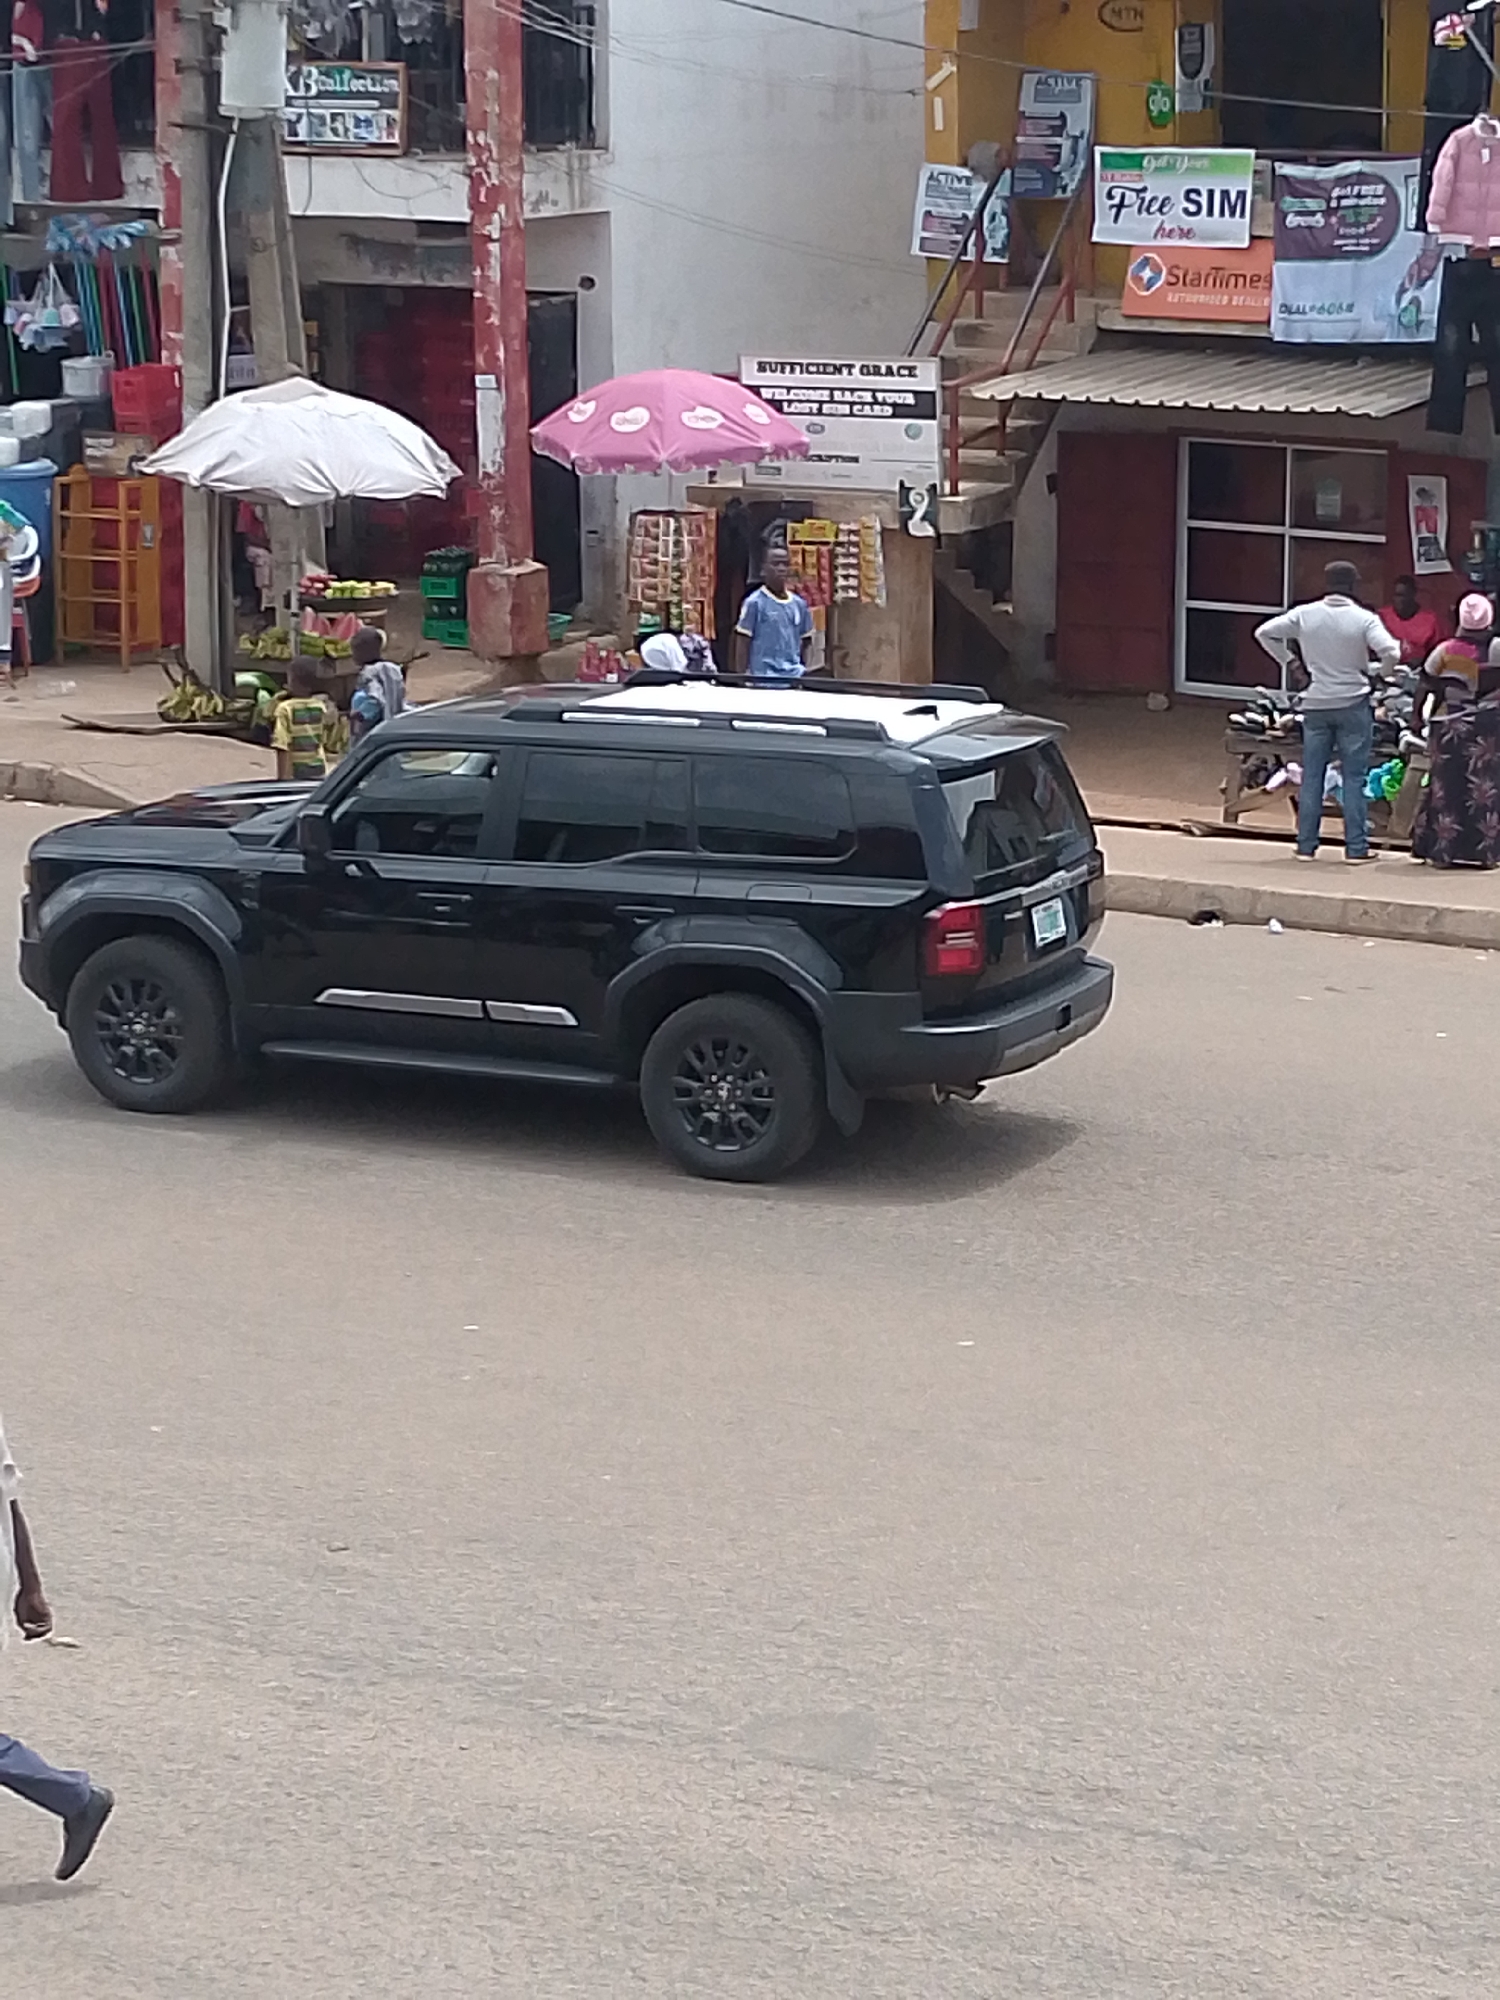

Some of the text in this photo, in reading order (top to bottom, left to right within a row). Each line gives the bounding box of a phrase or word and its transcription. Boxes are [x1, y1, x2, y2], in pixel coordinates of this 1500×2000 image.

[1149, 89, 1171, 117] glo
[1105, 185, 1248, 225] Free SIM
[1152, 220, 1197, 241] here
[1166, 265, 1271, 290] StarTimes
[756, 361, 918, 378] SUFFICIENT GRACE
[783, 402, 820, 413] LOST
